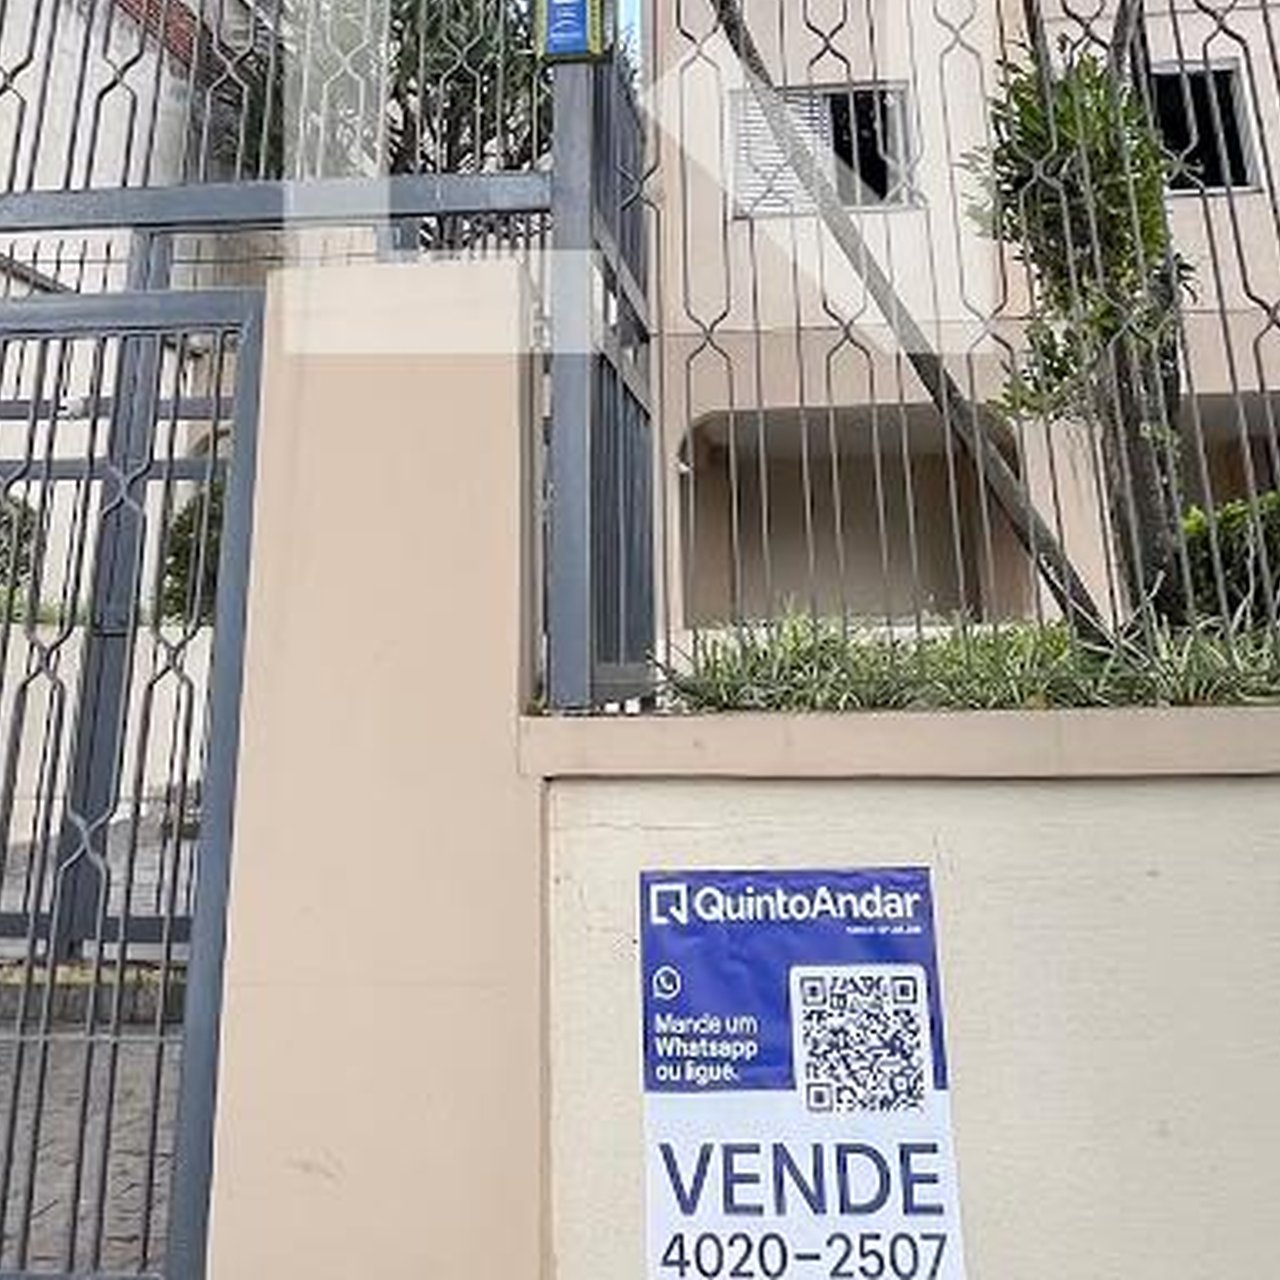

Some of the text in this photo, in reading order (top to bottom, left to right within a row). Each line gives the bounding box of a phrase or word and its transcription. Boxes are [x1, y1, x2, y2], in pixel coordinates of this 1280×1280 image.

[694, 885, 921, 922] QuintoAndar
[654, 1012, 758, 1035] Mande um
[654, 1036, 759, 1061] Whatsapp
[655, 1063, 681, 1081] ou
[659, 1142, 944, 1216] VENDE
[660, 1232, 948, 1280] 4020-2507
